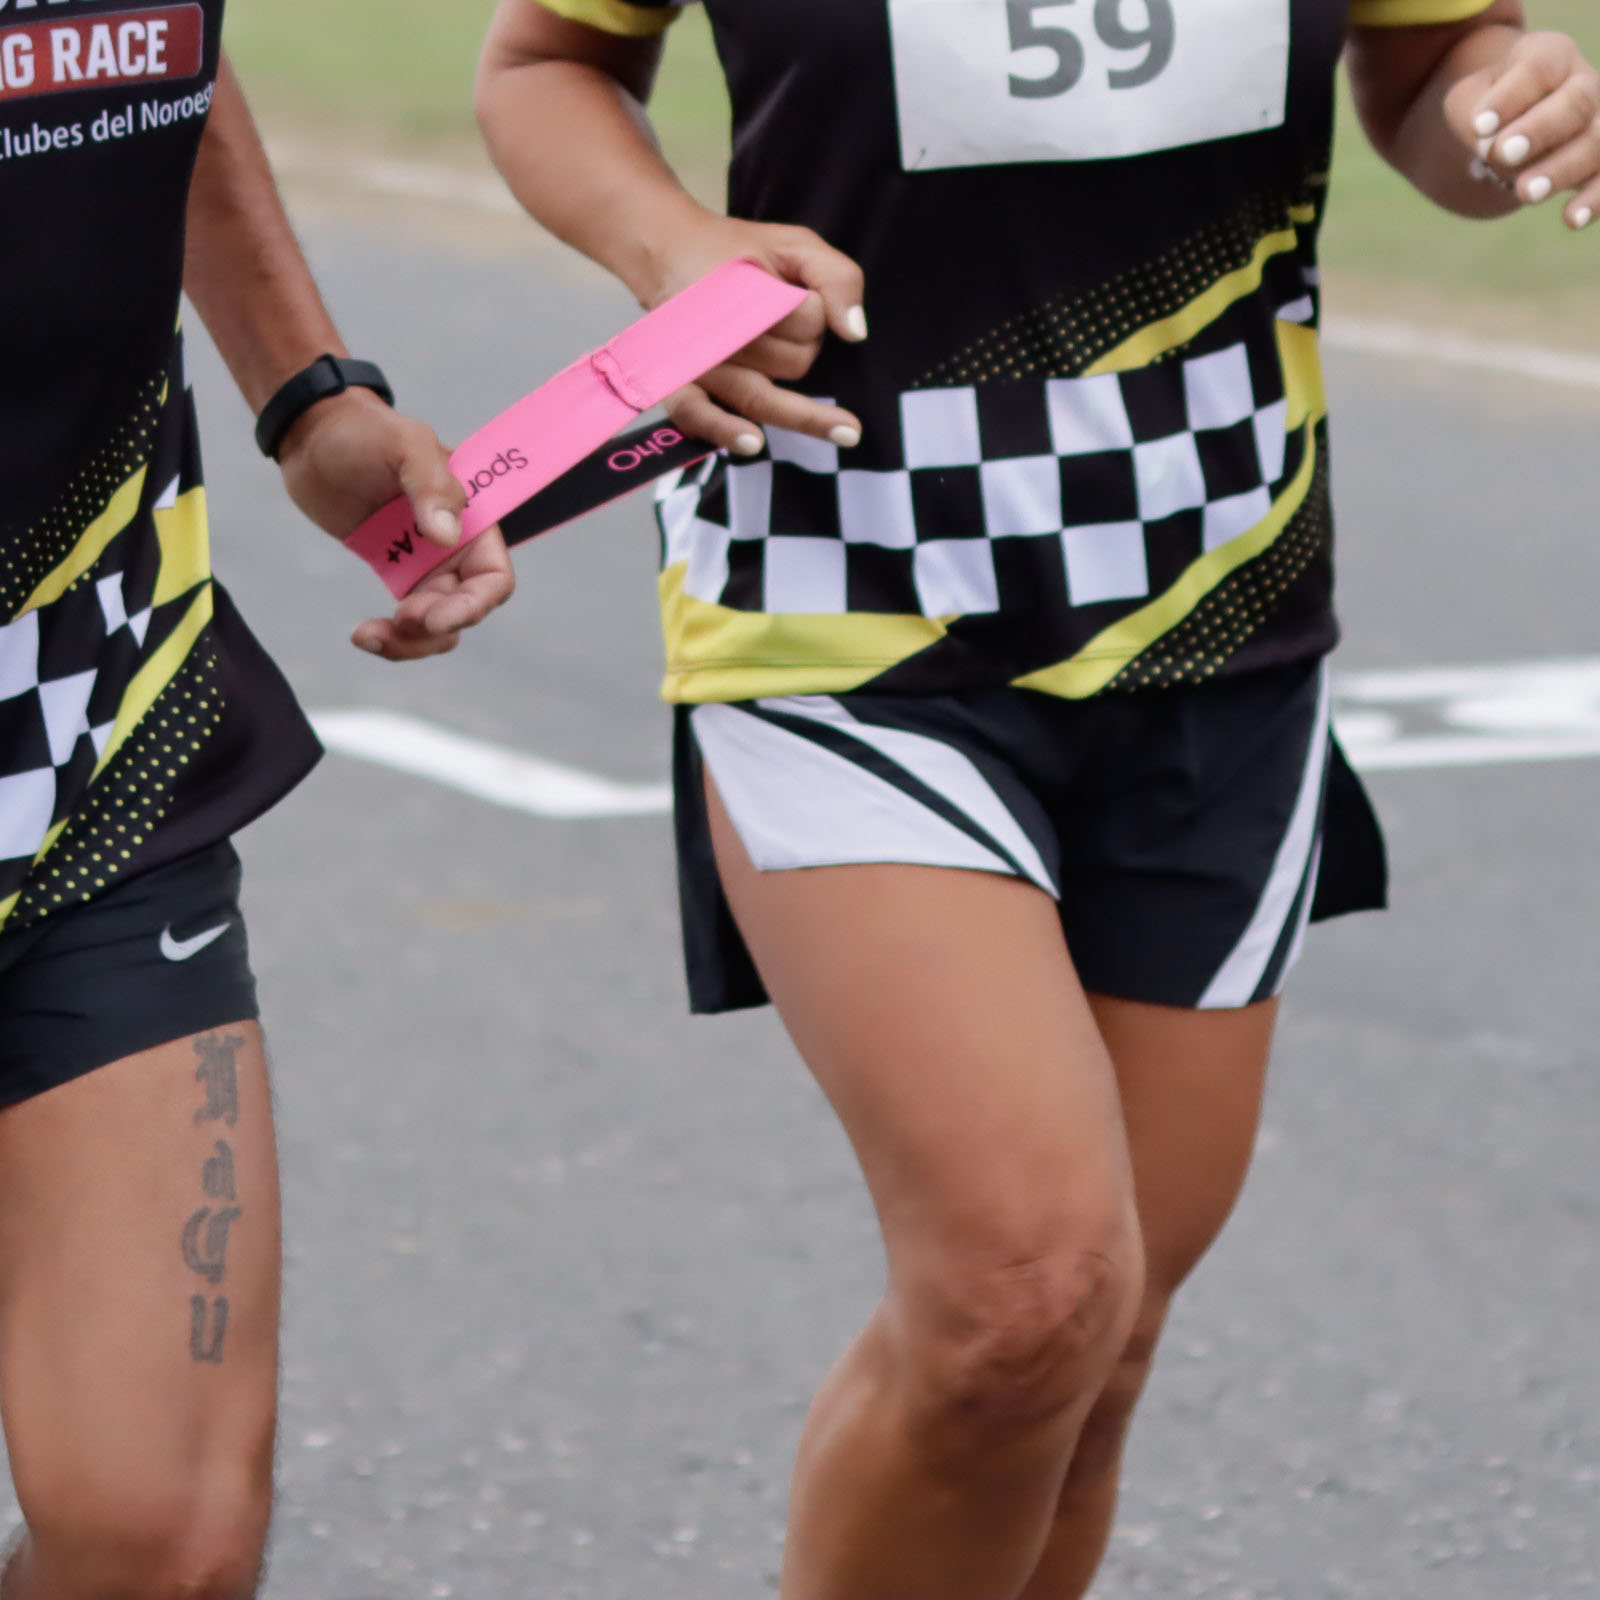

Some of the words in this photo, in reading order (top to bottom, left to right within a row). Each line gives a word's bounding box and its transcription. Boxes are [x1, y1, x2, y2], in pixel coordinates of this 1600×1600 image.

[49, 20, 169, 84] RACE
[90, 103, 133, 145] del
[141, 81, 216, 131] Noroest
[463, 448, 529, 509] Spor
